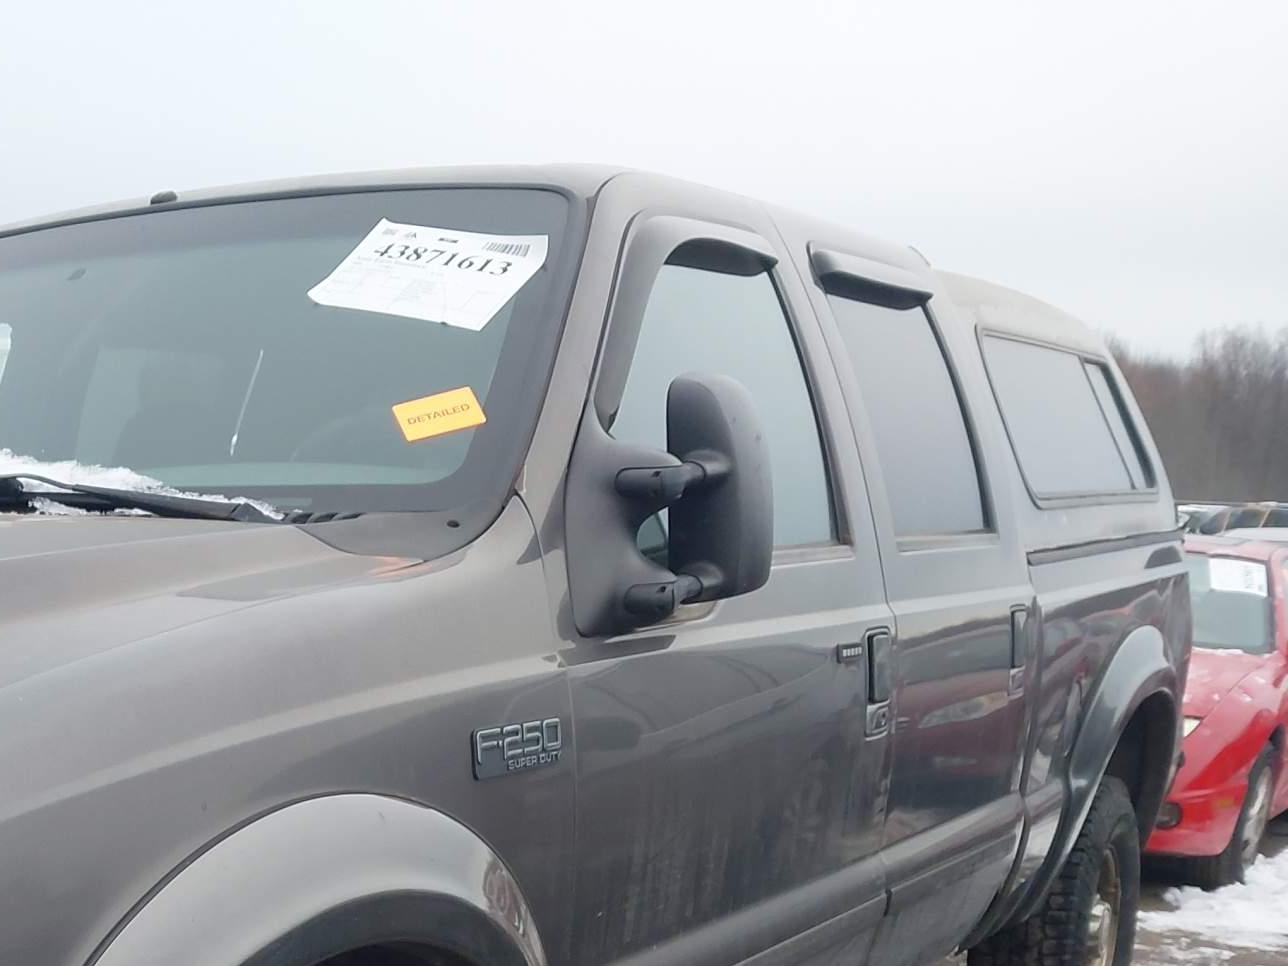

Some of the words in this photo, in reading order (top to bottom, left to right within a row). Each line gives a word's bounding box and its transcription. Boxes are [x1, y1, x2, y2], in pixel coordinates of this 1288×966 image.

[373, 243, 513, 276] 43871613
[406, 403, 471, 426] DETAILED
[507, 754, 538, 770] SUPER
[539, 751, 562, 764] DUTY
